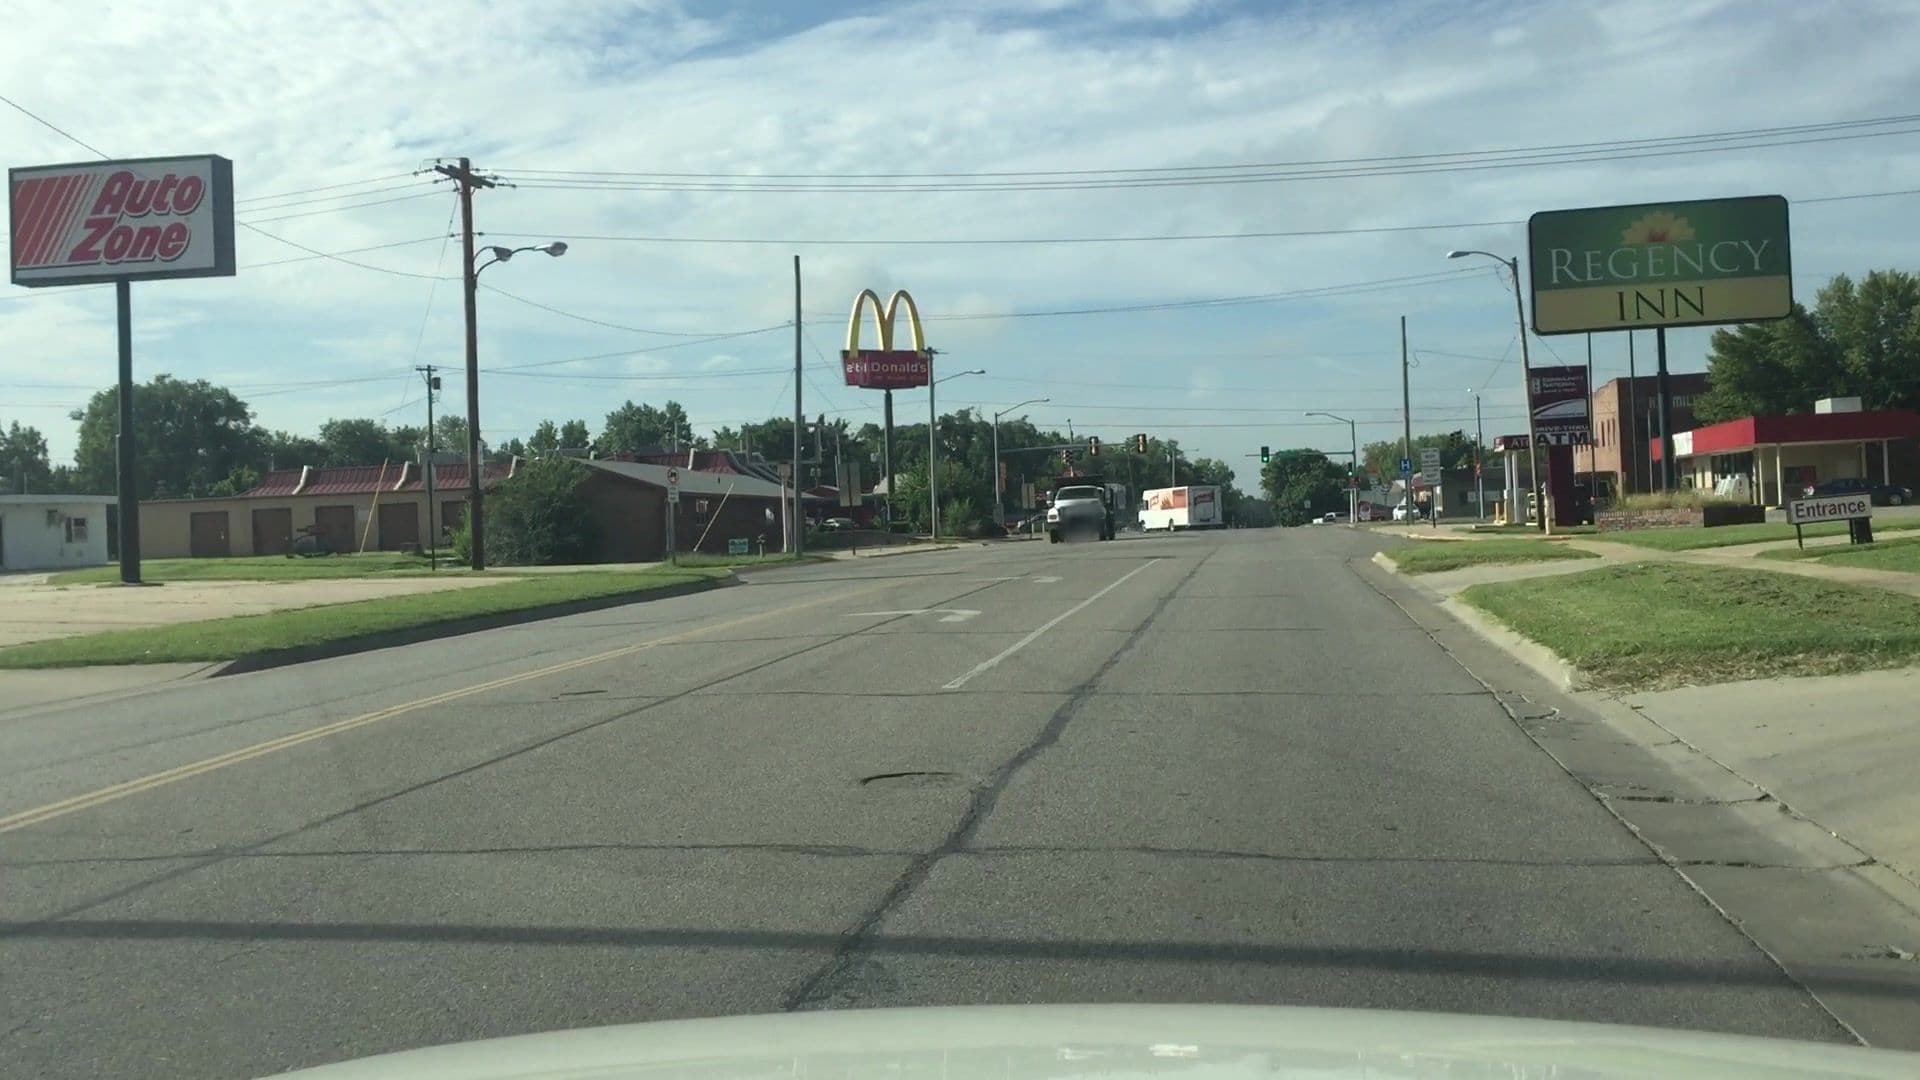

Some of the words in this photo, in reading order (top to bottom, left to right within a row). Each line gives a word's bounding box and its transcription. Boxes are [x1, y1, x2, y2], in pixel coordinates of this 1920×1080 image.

[90, 169, 204, 216] Auto
[67, 216, 190, 263] Zone
[1548, 239, 1769, 284] REGENCY
[1617, 286, 1705, 321] INN
[847, 361, 928, 374] Donald's
[1536, 432, 1588, 445] ATM
[1401, 459, 1410, 470] H
[1794, 499, 1866, 519] Entrance
